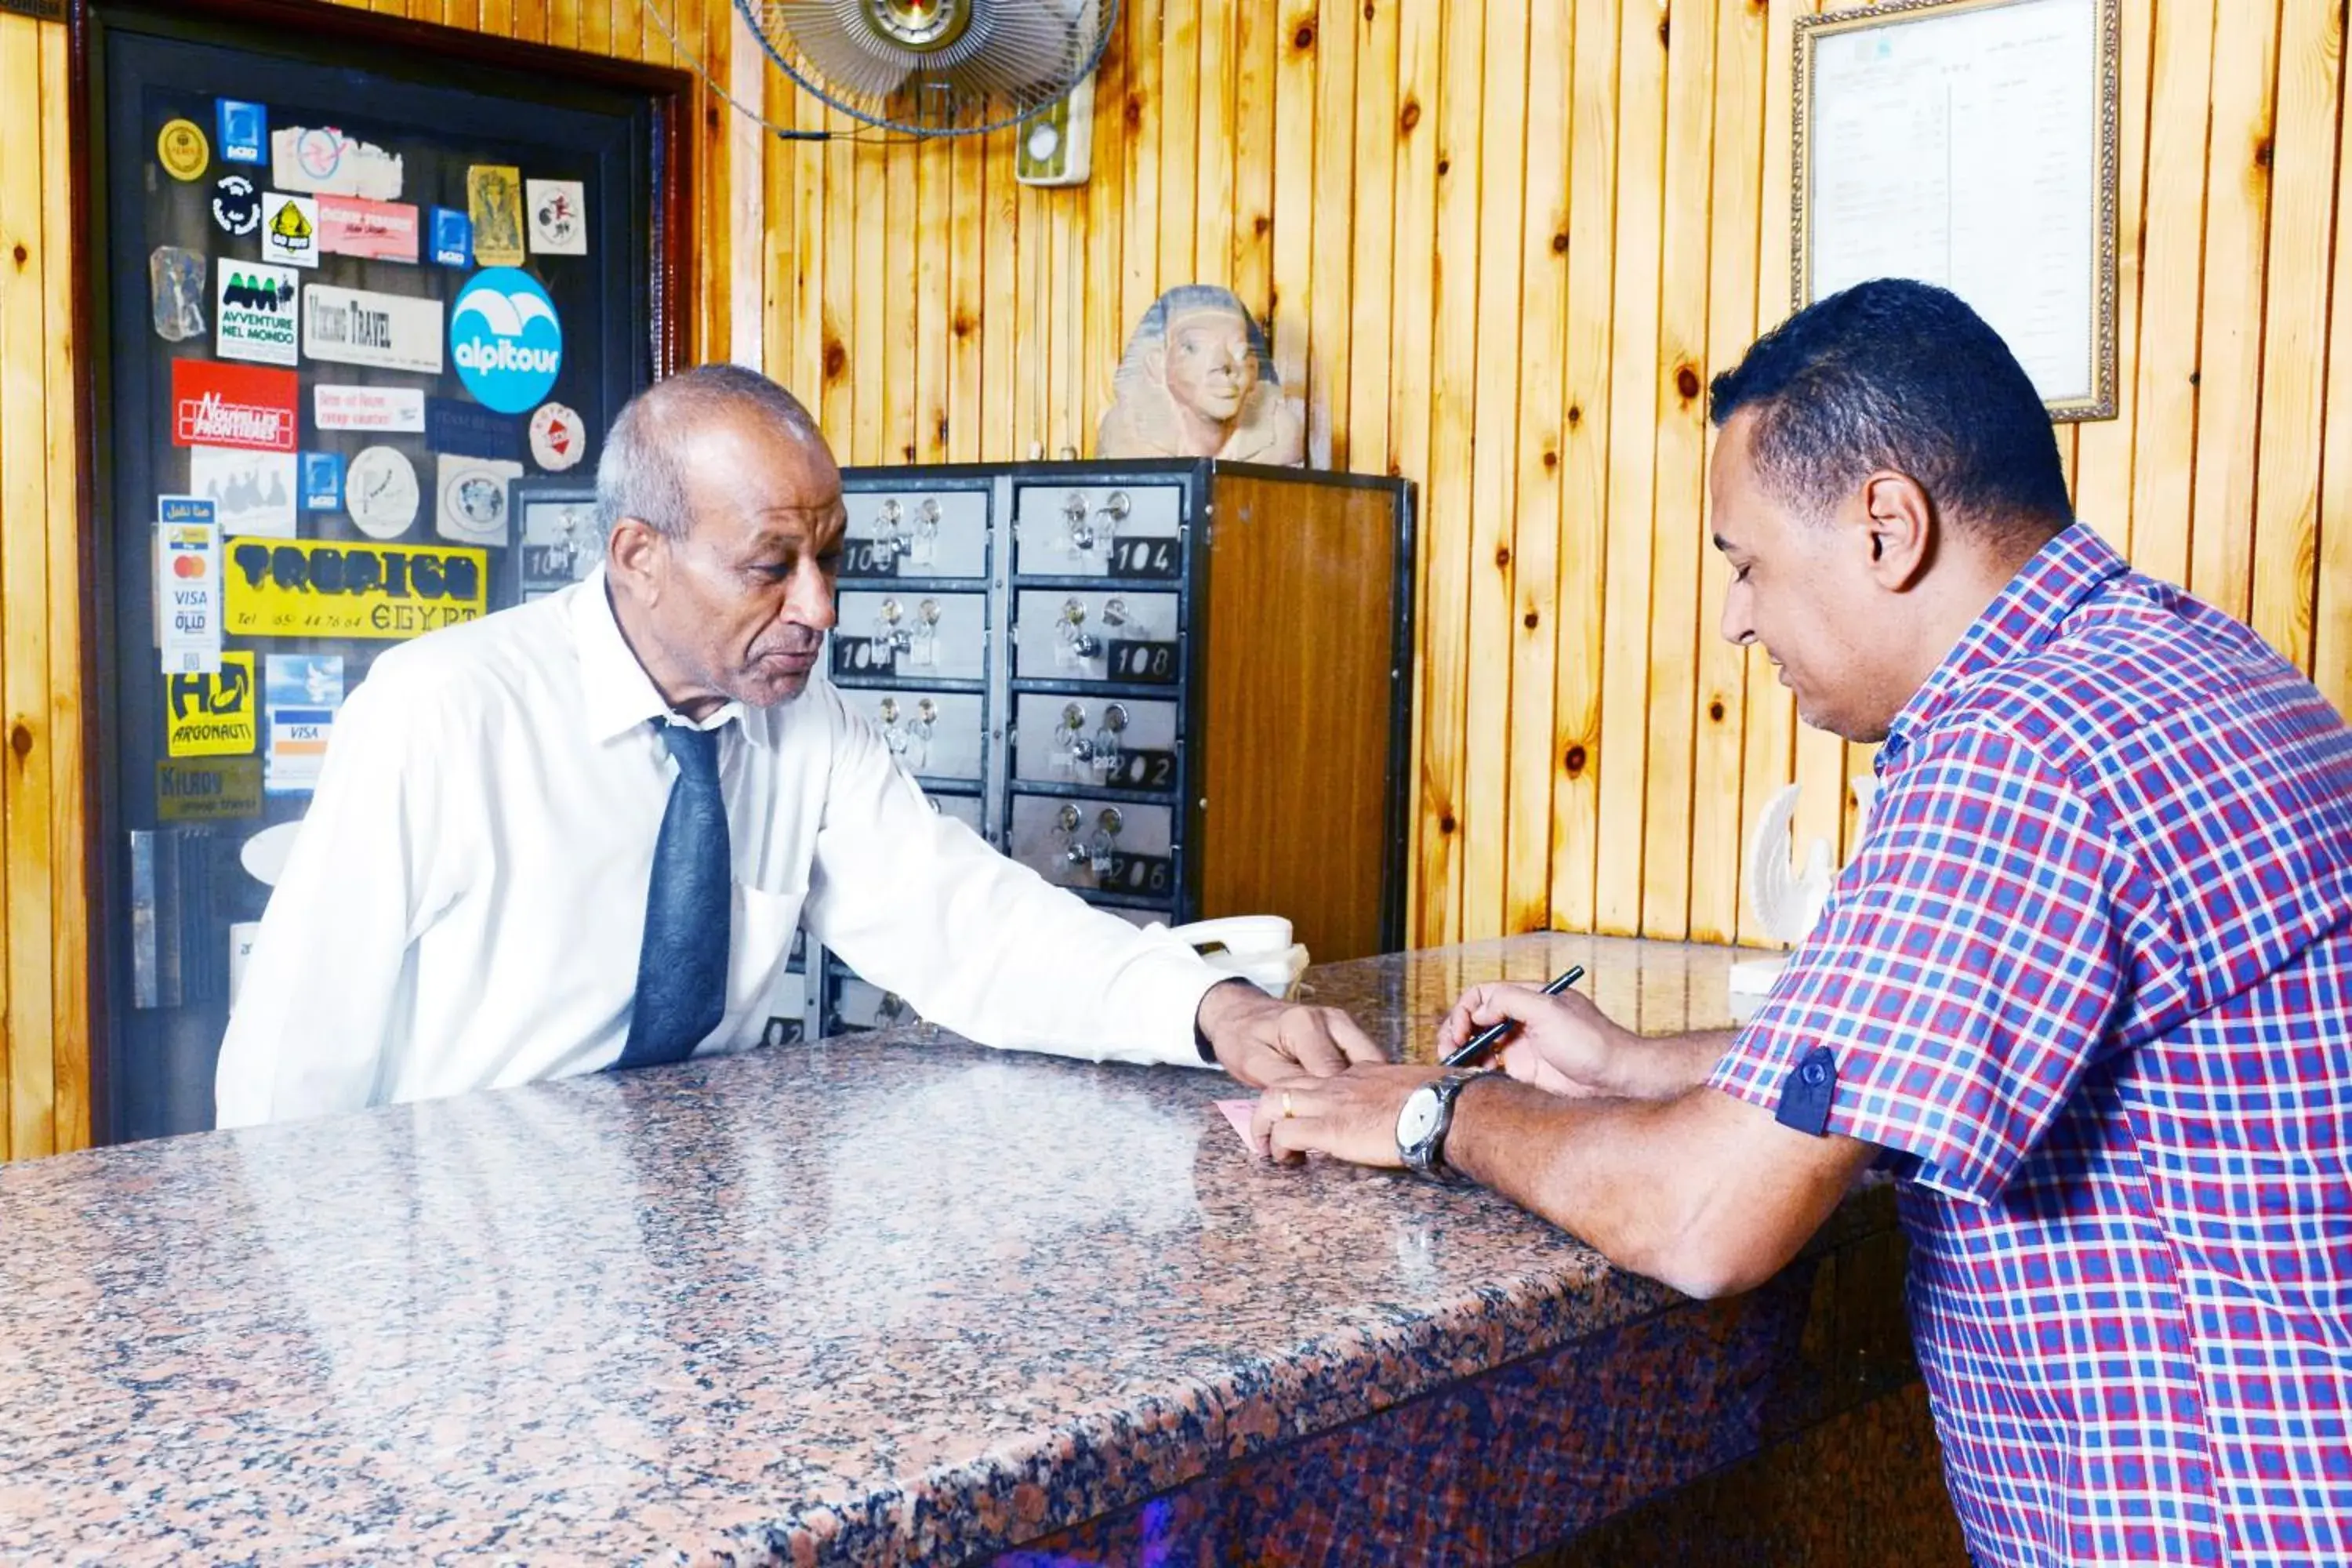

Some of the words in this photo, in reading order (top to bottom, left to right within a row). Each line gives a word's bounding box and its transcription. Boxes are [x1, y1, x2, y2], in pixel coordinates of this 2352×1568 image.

[223, 310, 293, 329] AVVENTURE
[223, 325, 244, 338] NEL
[247, 328, 294, 344] MONDO
[455, 336, 559, 376] alpitour
[1119, 542, 1169, 572] 104
[173, 590, 208, 605] VISA
[238, 612, 256, 626] Tel
[372, 604, 477, 631] EGYPT
[843, 642, 886, 670] 10
[1117, 646, 1169, 675] 108
[172, 723, 252, 745] ARGONAUTI
[289, 726, 318, 739] VISA
[1109, 754, 1170, 786] 202
